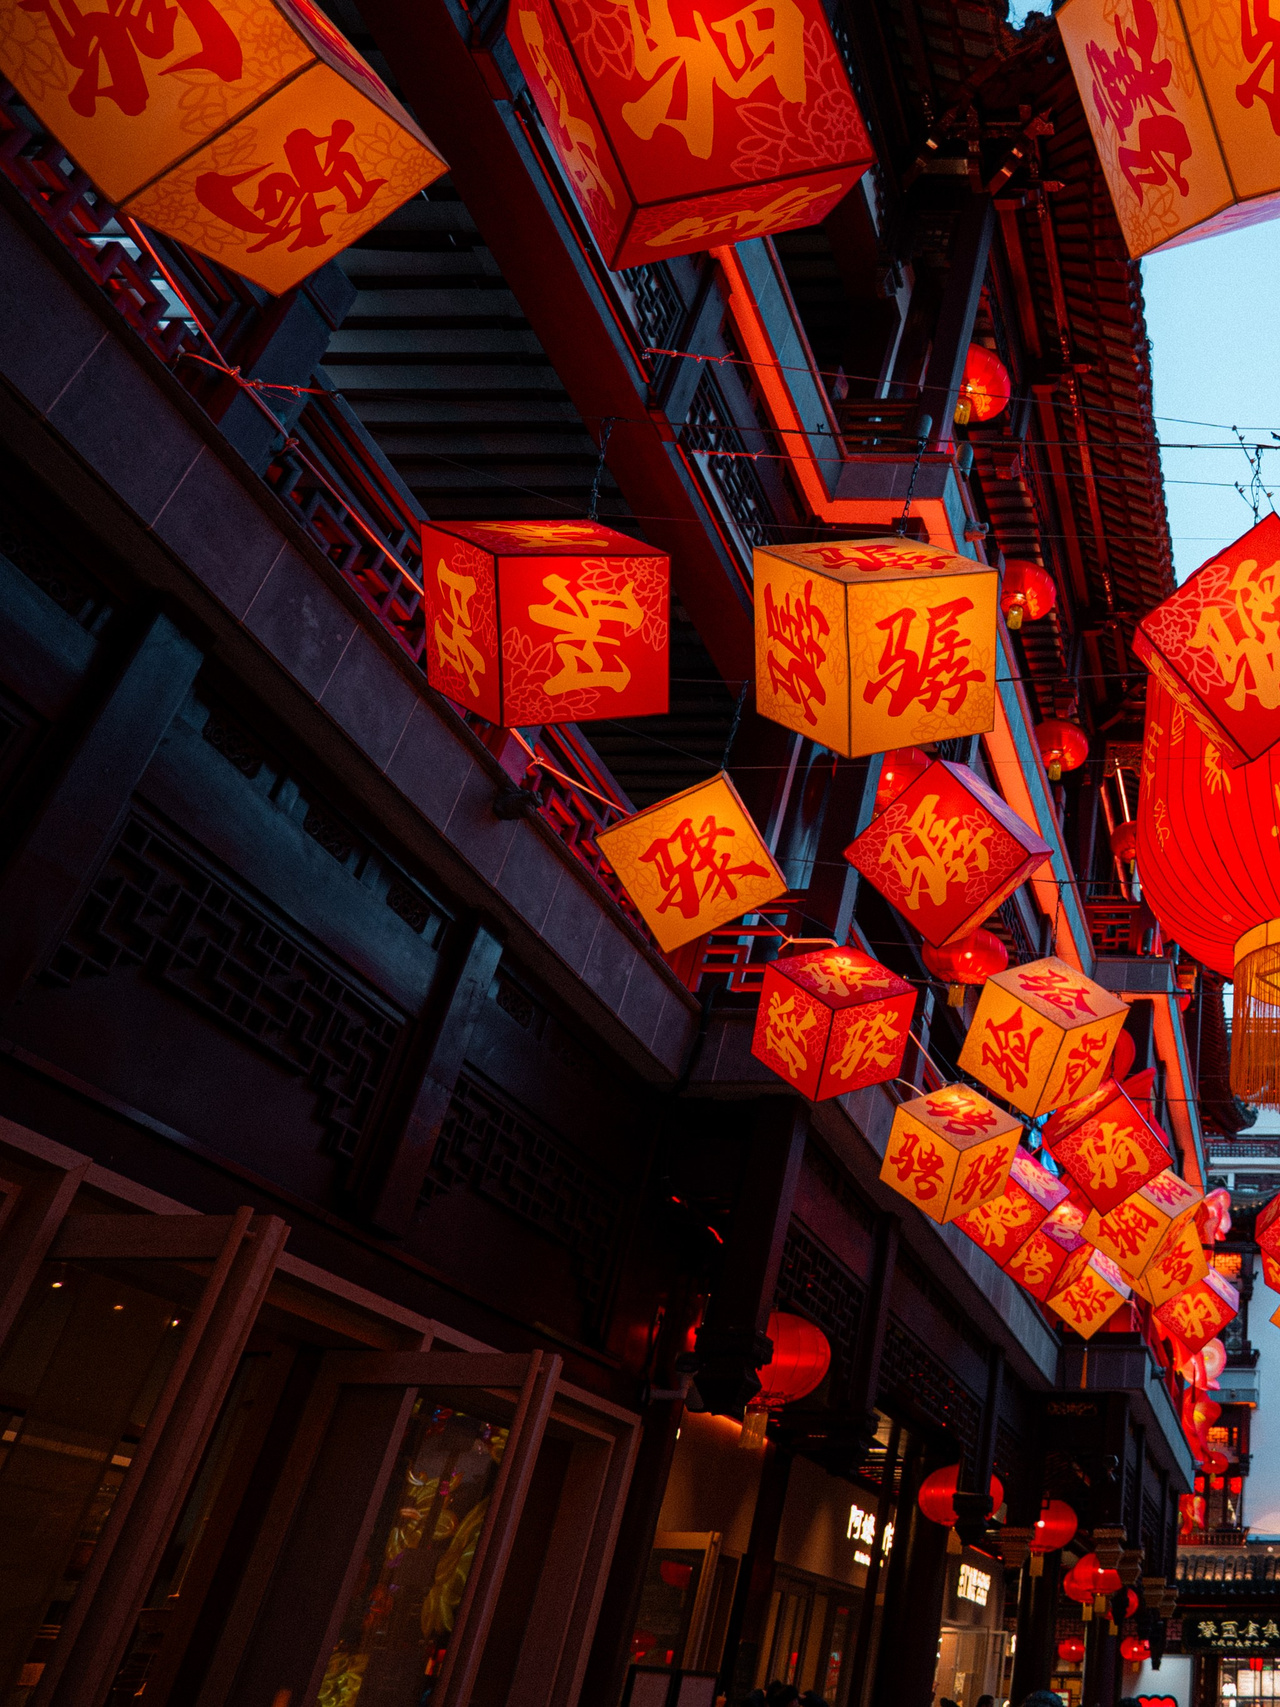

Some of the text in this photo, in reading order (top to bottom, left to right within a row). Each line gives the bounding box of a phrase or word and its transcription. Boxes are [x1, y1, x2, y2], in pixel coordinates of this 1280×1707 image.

[195, 119, 388, 253] 骑
[863, 597, 987, 717] 骣
[638, 815, 771, 920] 骤
[982, 1007, 1043, 1093] 验
[890, 1133, 945, 1201] 骋
[1079, 1122, 1149, 1190] 骑
